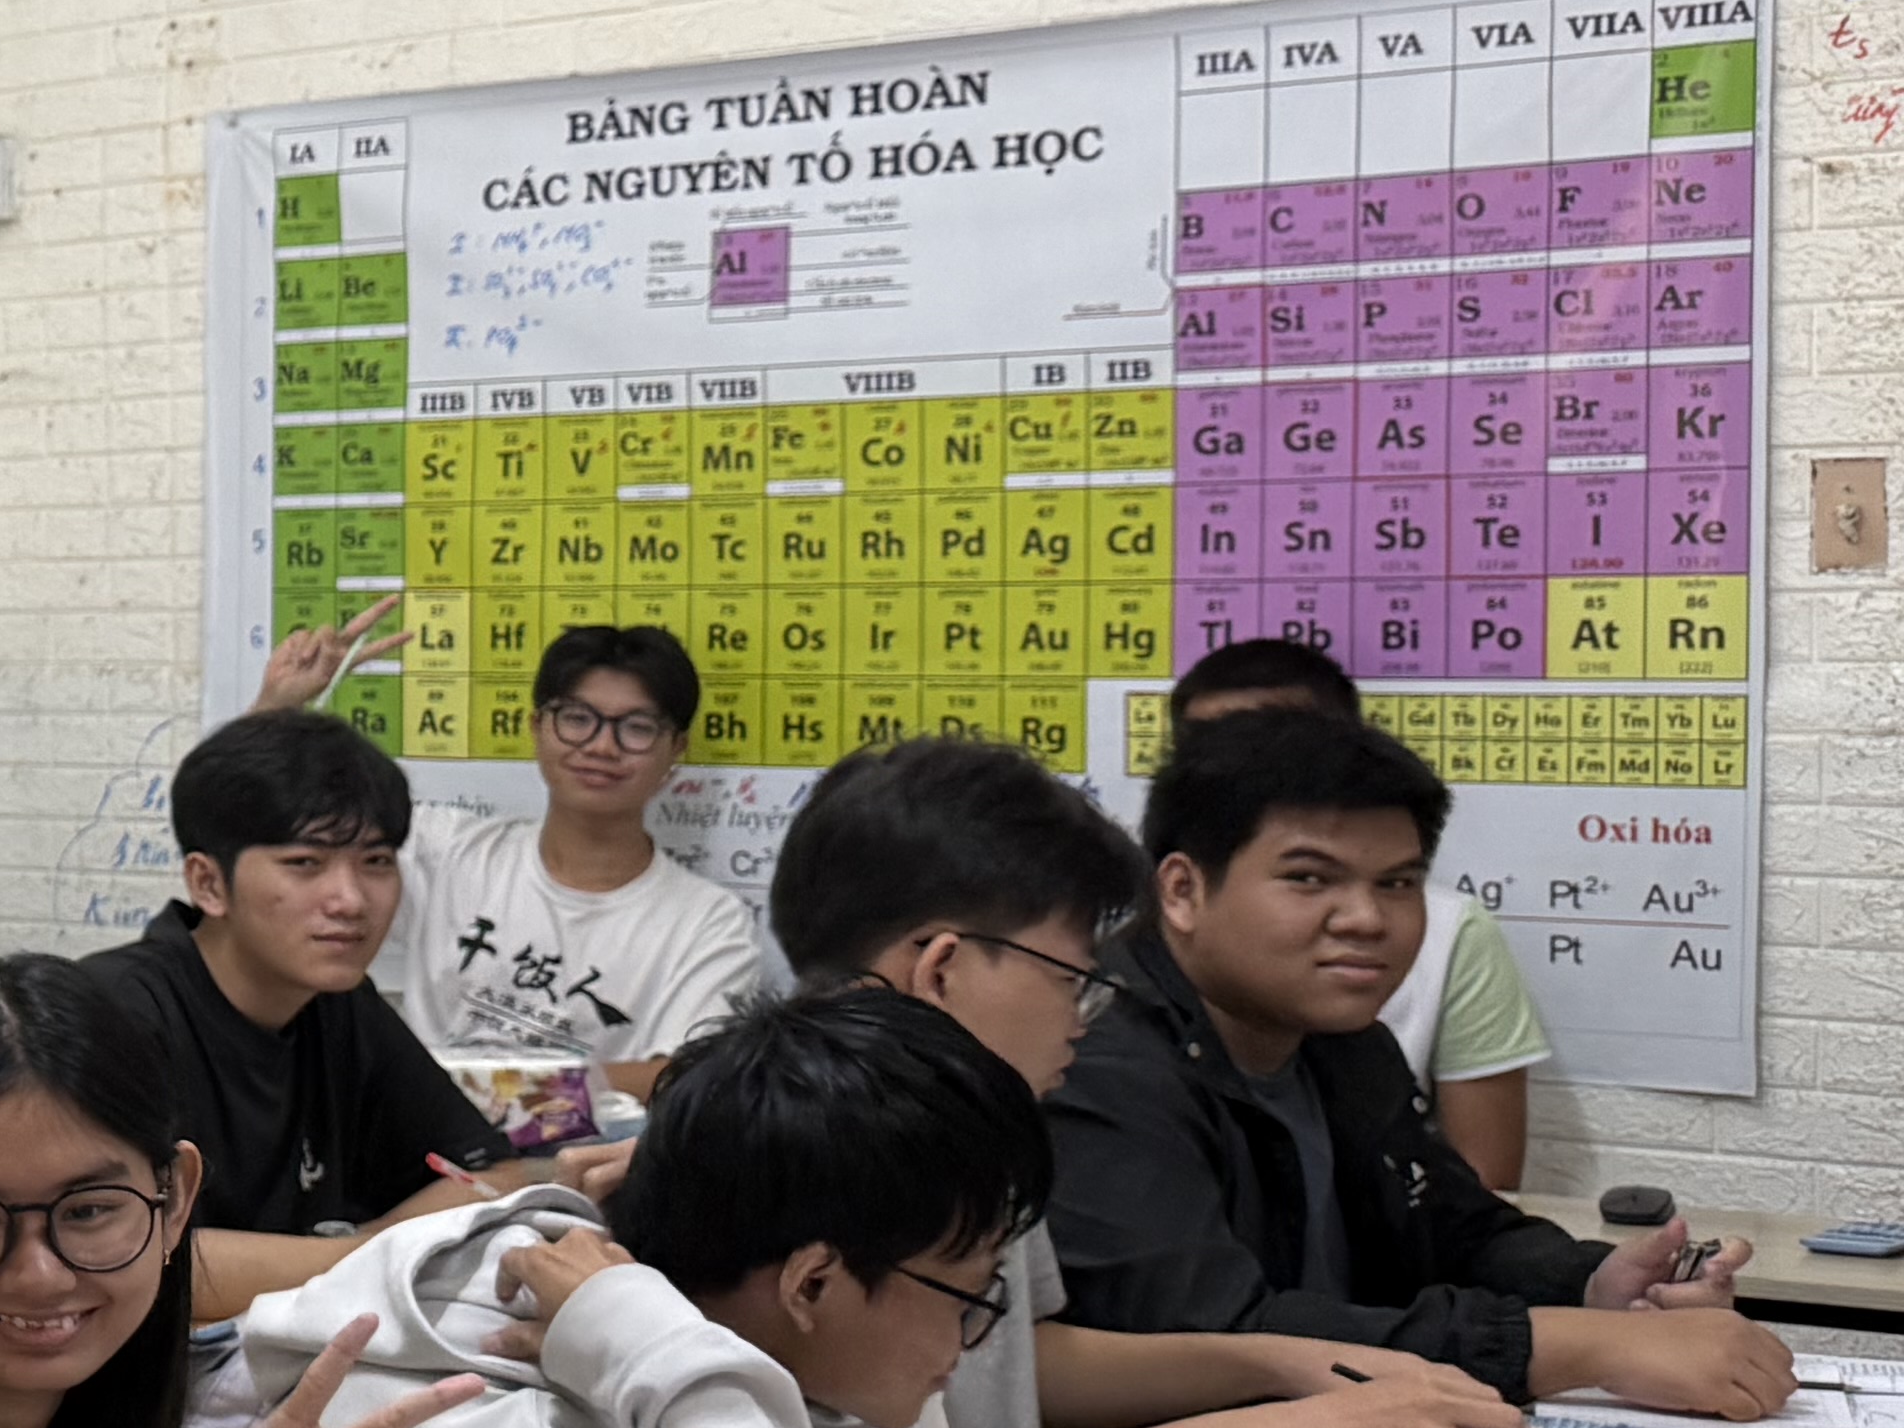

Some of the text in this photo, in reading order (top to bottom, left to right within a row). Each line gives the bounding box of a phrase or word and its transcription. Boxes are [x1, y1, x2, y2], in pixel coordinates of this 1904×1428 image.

[1566, 10, 1646, 39] VIIA
[1657, 0, 1754, 32] VIIIA
[1379, 33, 1423, 58] VA
[1471, 22, 1534, 49] VIA
[1197, 49, 1255, 75] IIIA
[1283, 41, 1339, 68] IVA
[1656, 75, 1710, 103] He
[566, 64, 991, 145] BẢNG TUẦN HOÀN
[290, 144, 315, 163] IA
[354, 136, 390, 158] IIA
[483, 125, 1104, 212] CÁC NGUYÊN TỐ HÓA HỌC
[1558, 187, 1581, 213] F
[1655, 178, 1706, 206] Ne
[279, 197, 299, 219] H
[1270, 206, 1294, 234] C
[1362, 200, 1388, 228] N
[1456, 193, 1485, 220] O
[1181, 214, 1204, 240] B
[715, 250, 748, 277] Al
[1457, 296, 1481, 323] S
[1554, 290, 1594, 317] Cl
[1655, 285, 1704, 311] Ar
[1179, 311, 1217, 337] Al
[1270, 305, 1306, 333] Si
[1363, 301, 1388, 328] P
[342, 361, 381, 386] Mg
[844, 371, 916, 394] VIIIB
[1034, 364, 1066, 386] IB
[1107, 359, 1152, 382] IIB
[419, 392, 466, 414] IIIB
[492, 389, 536, 411] IVB
[570, 384, 606, 407] VB
[627, 383, 673, 404] VIB
[700, 377, 758, 401] VIIB
[1555, 396, 1600, 421] Br
[1009, 416, 1053, 441] Cu
[1094, 414, 1137, 438] Zn
[1283, 422, 1336, 452] Ge
[1377, 418, 1426, 450] As
[1474, 415, 1523, 446] Se
[1676, 407, 1726, 439] Kr
[620, 432, 653, 456] Cr
[772, 427, 805, 450] Fe
[861, 438, 905, 467] Co
[945, 435, 983, 464] Ni
[1193, 426, 1244, 456] Ga
[342, 442, 374, 466] Ca
[422, 453, 457, 481] Sc
[497, 450, 525, 478] Ti
[571, 449, 592, 477] V
[703, 445, 754, 472] Mn
[942, 528, 985, 558] Pd
[1107, 524, 1154, 555] Cd
[1200, 524, 1236, 554] In
[1284, 521, 1332, 553] Sn
[1375, 519, 1426, 551] Sb
[1474, 517, 1521, 549] Te
[1591, 515, 1602, 547] I
[1671, 512, 1726, 546] Xe
[286, 541, 325, 568] Rb
[428, 538, 449, 565] Y
[492, 538, 526, 566] Zr
[558, 536, 604, 563] Nb
[629, 535, 679, 563] Mo
[712, 533, 746, 561] Tc
[783, 532, 826, 560] Ru
[861, 530, 905, 560] Rh
[1022, 527, 1071, 564] Ag
[419, 625, 454, 651] La
[491, 623, 526, 650] Hf
[708, 624, 748, 652] Re
[783, 623, 825, 651] Os
[871, 623, 895, 650] Ir
[945, 623, 981, 651] Pt
[1020, 623, 1069, 651] Au
[1104, 623, 1156, 659] Hg
[1382, 620, 1419, 650] Bi
[1471, 619, 1523, 651] Po
[1571, 619, 1619, 650] At
[1669, 619, 1725, 650] Rn
[351, 708, 386, 733] Ra
[419, 709, 455, 736] Ac
[491, 708, 524, 736] Rf
[705, 712, 747, 741] Bh
[783, 713, 823, 741] Hs
[1712, 714, 1736, 729] Lu
[1022, 717, 1066, 753] Rg
[1578, 814, 1713, 845] Oxi hóa
[1549, 935, 1723, 972] Pt Au
